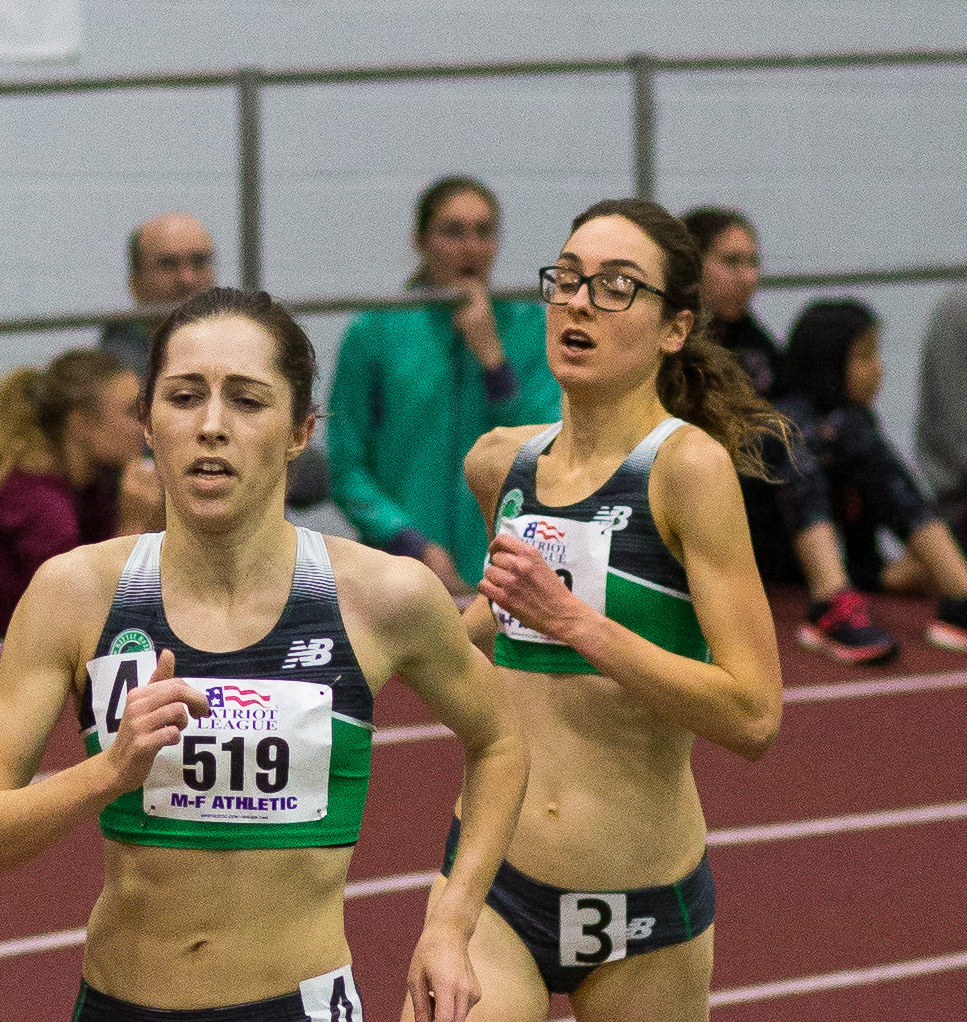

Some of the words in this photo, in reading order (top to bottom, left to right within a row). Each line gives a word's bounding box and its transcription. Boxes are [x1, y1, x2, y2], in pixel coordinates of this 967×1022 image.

[211, 708, 278, 720] ATRIOT
[197, 717, 278, 731] LEAGUE
[183, 735, 289, 794] 519
[171, 792, 206, 809] M-F
[211, 796, 298, 811] ATHLETIC
[575, 898, 613, 963] 3
